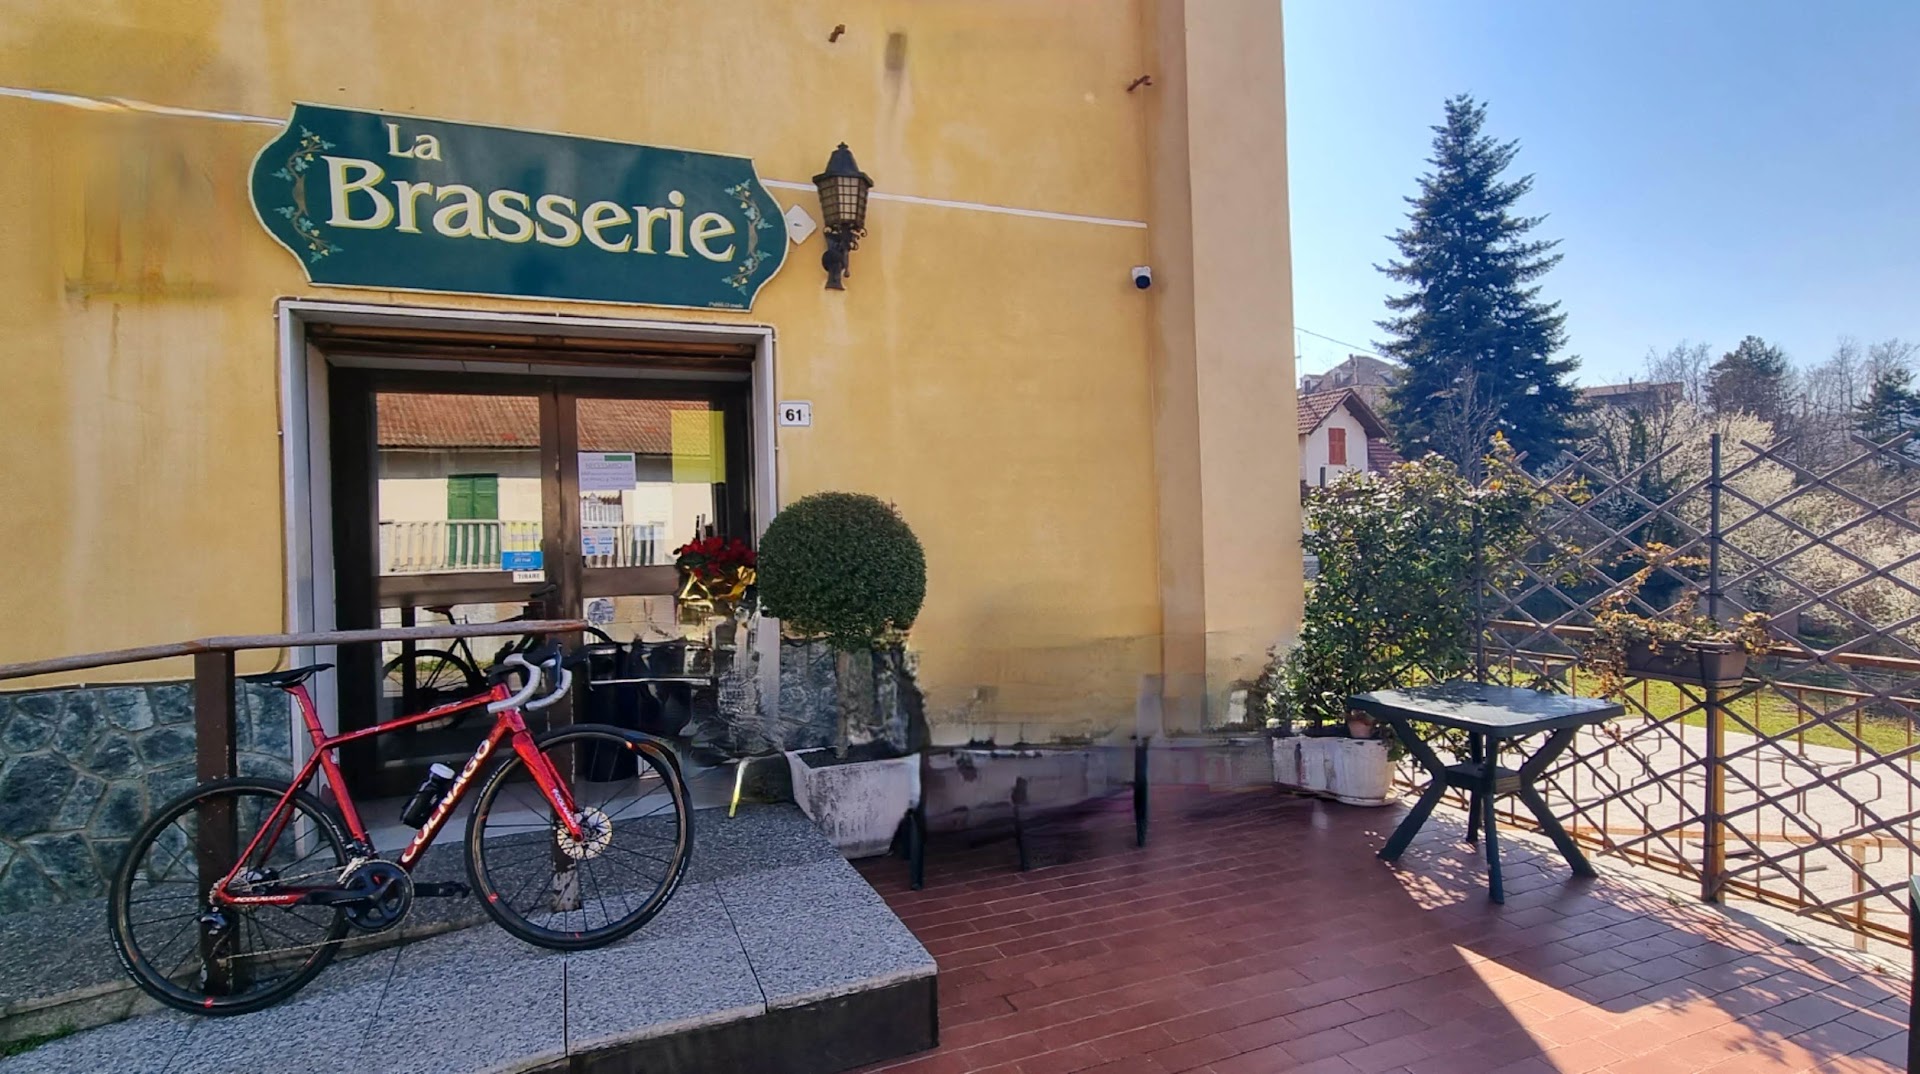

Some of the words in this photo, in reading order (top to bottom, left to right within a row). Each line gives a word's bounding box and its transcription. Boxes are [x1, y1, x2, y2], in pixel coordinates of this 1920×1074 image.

[386, 123, 442, 161] La
[320, 155, 736, 263] Brasserie
[785, 408, 802, 422] 61
[401, 739, 490, 863] COLNAGO
